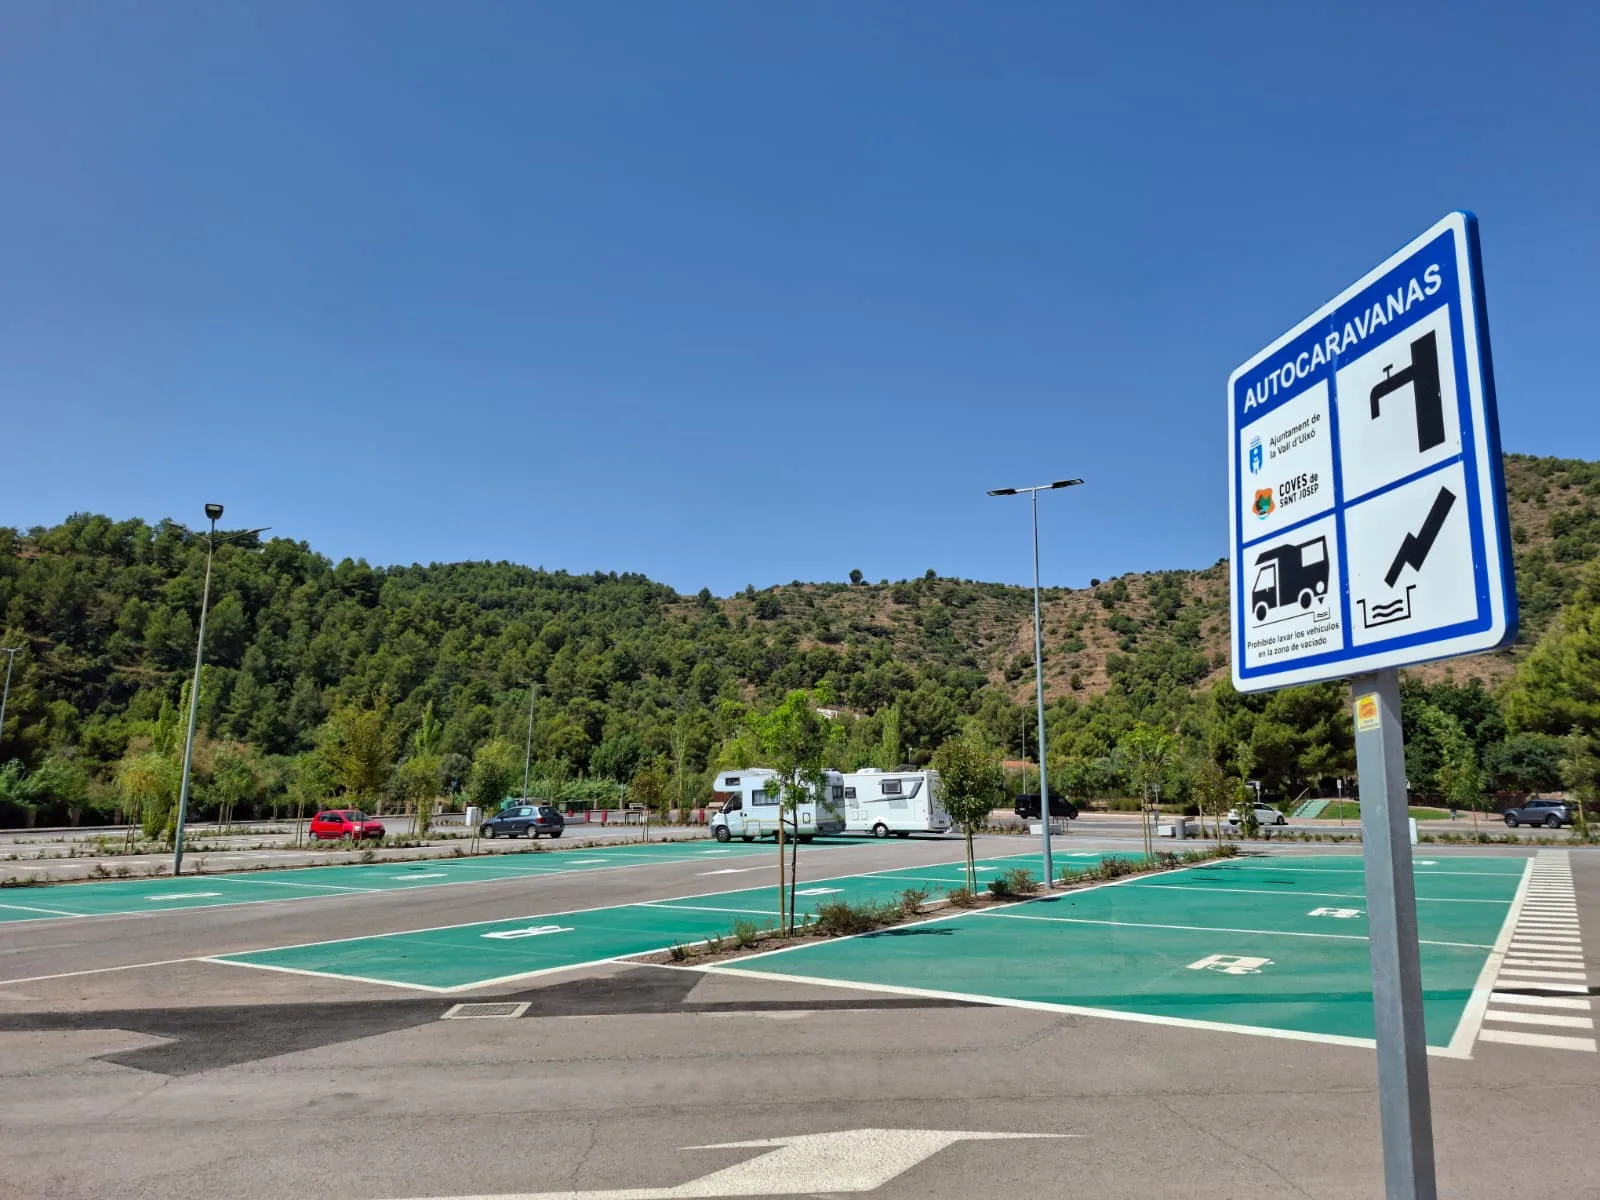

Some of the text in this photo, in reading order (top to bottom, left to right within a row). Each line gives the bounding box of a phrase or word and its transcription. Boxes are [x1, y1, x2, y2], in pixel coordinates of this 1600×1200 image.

[1243, 263, 1442, 414] AUTOCARAVANAS
[1270, 413, 1320, 448] Ajuntament de
[1279, 473, 1318, 497] COVES de
[1279, 483, 1318, 508] SANT JOSEP
[1247, 636, 1277, 649] Prohibido
[1295, 629, 1305, 639] los
[1274, 645, 1290, 655] zona
[1291, 642, 1299, 651] de
[1301, 637, 1327, 649] vaciado
